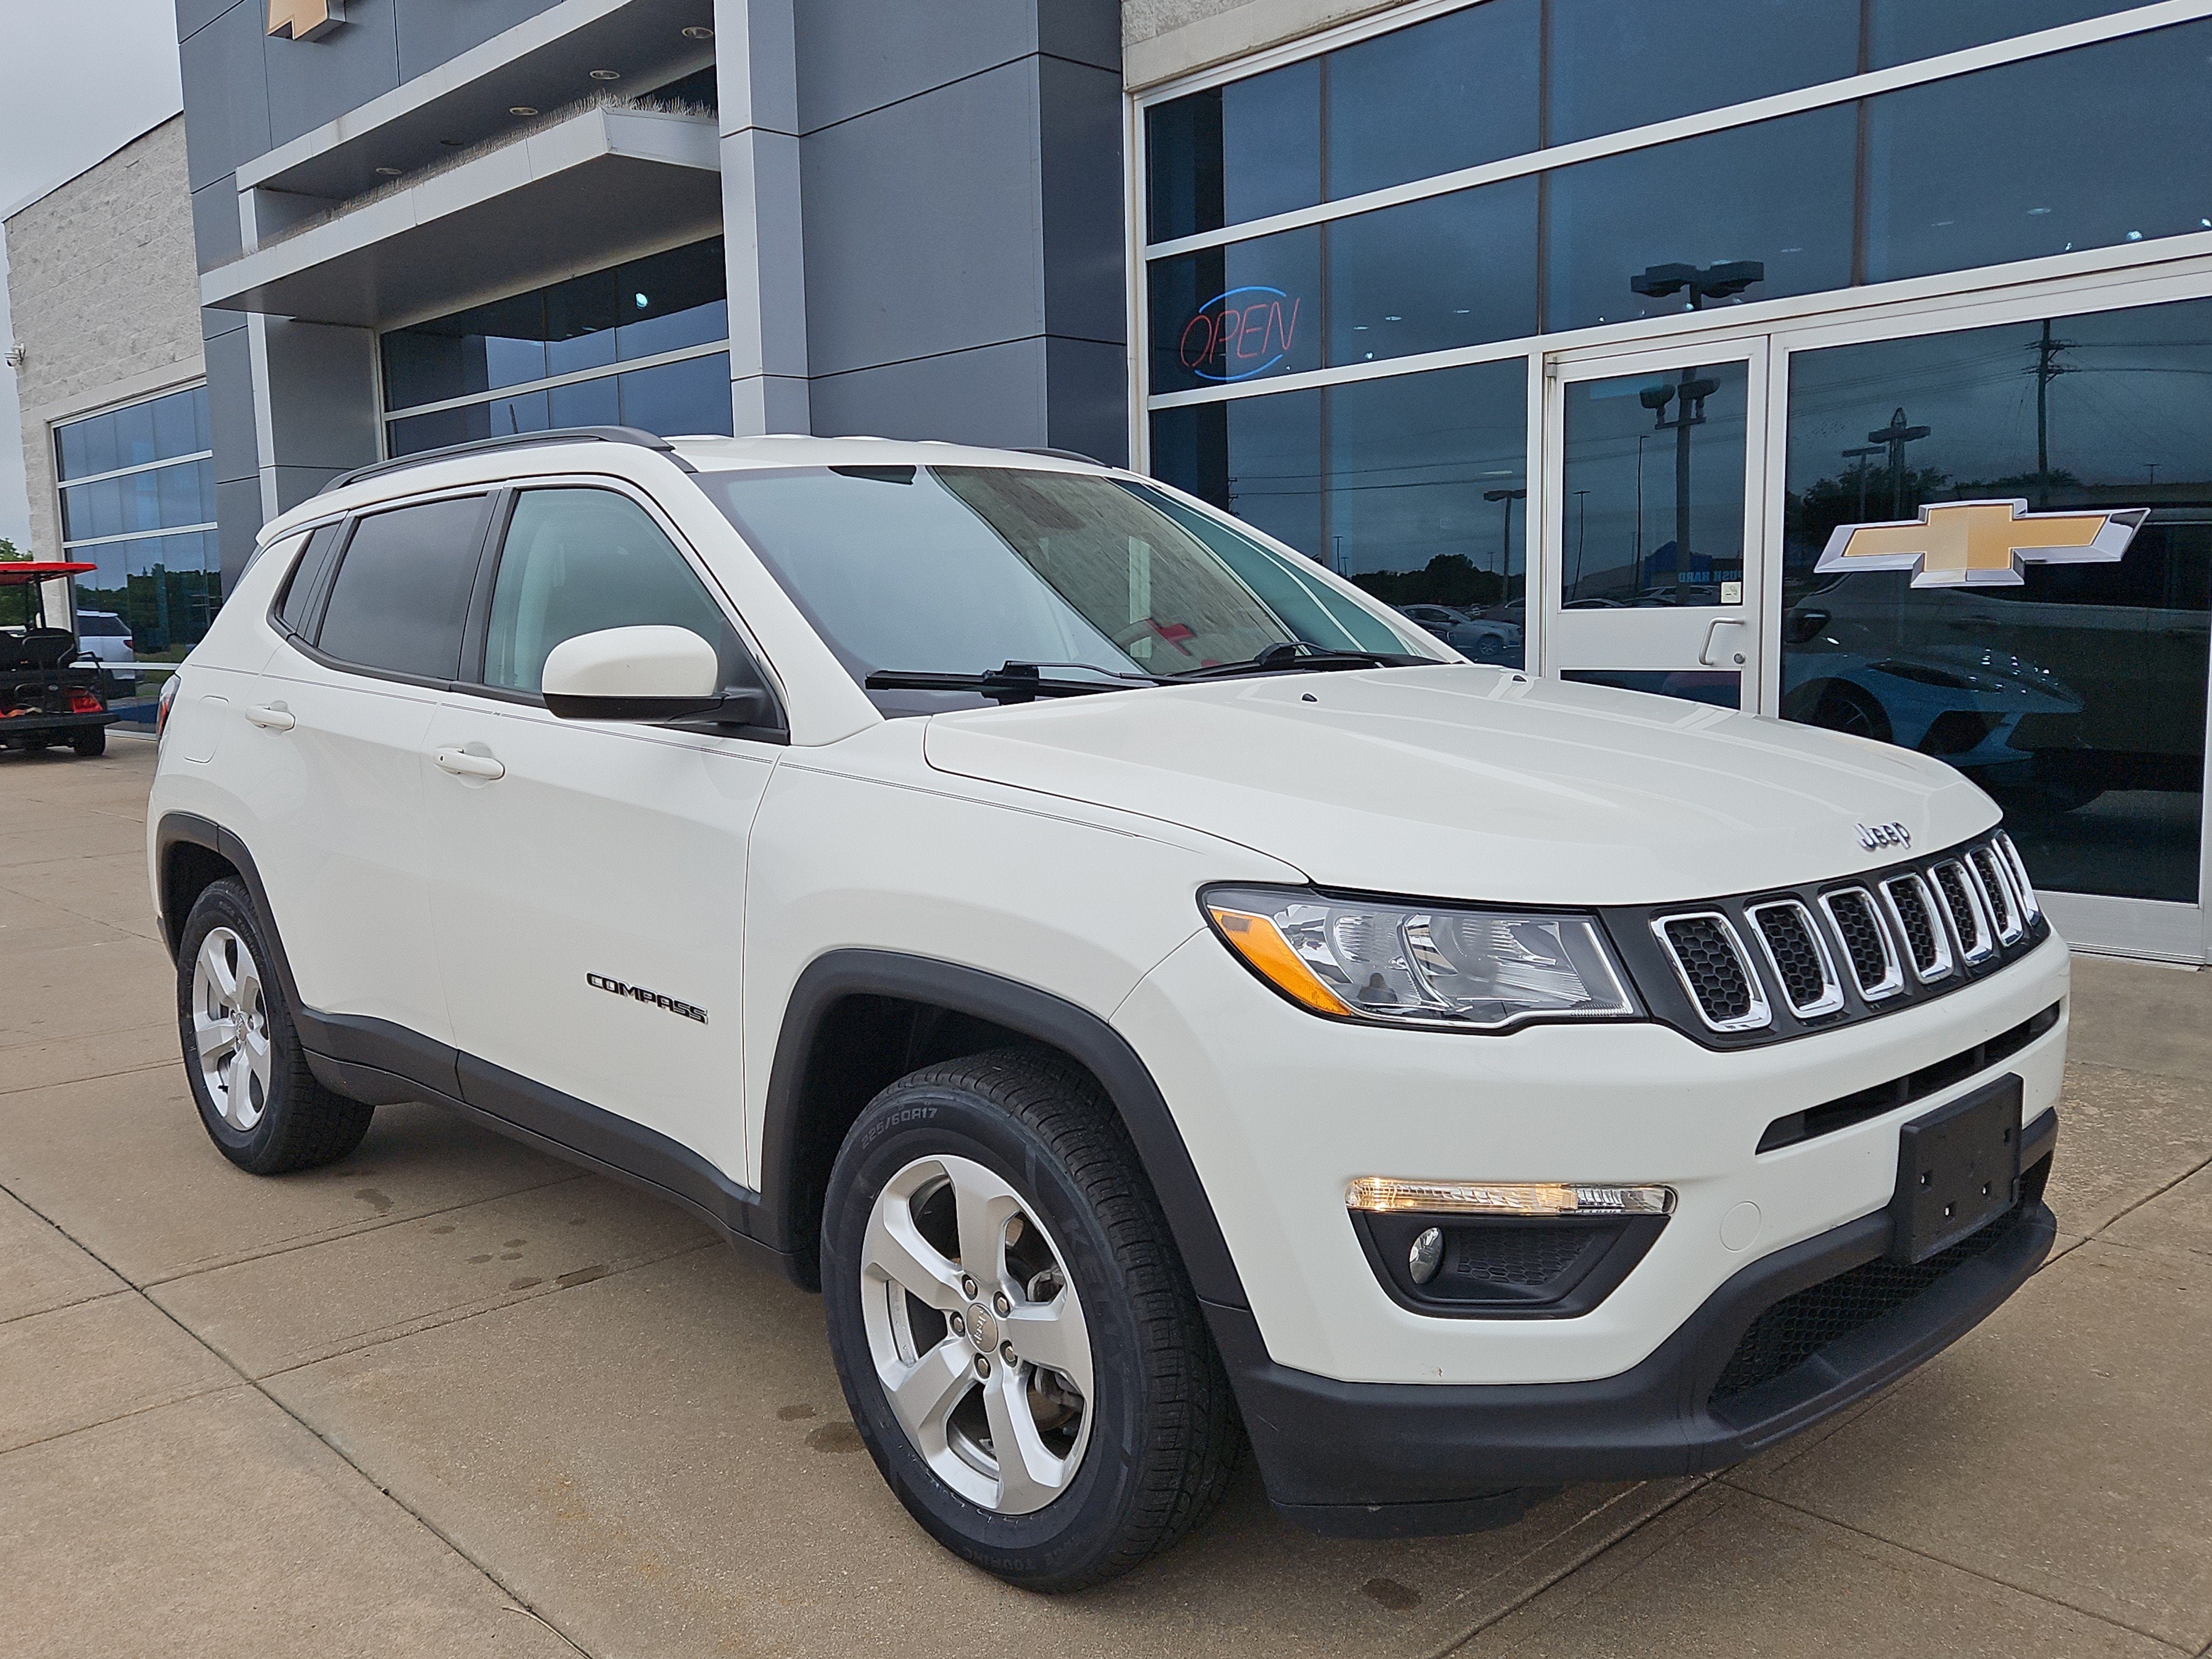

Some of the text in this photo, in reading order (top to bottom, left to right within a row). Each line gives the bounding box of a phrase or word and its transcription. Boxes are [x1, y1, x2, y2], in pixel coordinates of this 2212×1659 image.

[1180, 297, 1300, 368] OPEN
[1854, 822, 1912, 853] Jeep
[586, 972, 708, 1025] COMPASS
[860, 1107, 938, 1150] 225/60R17
